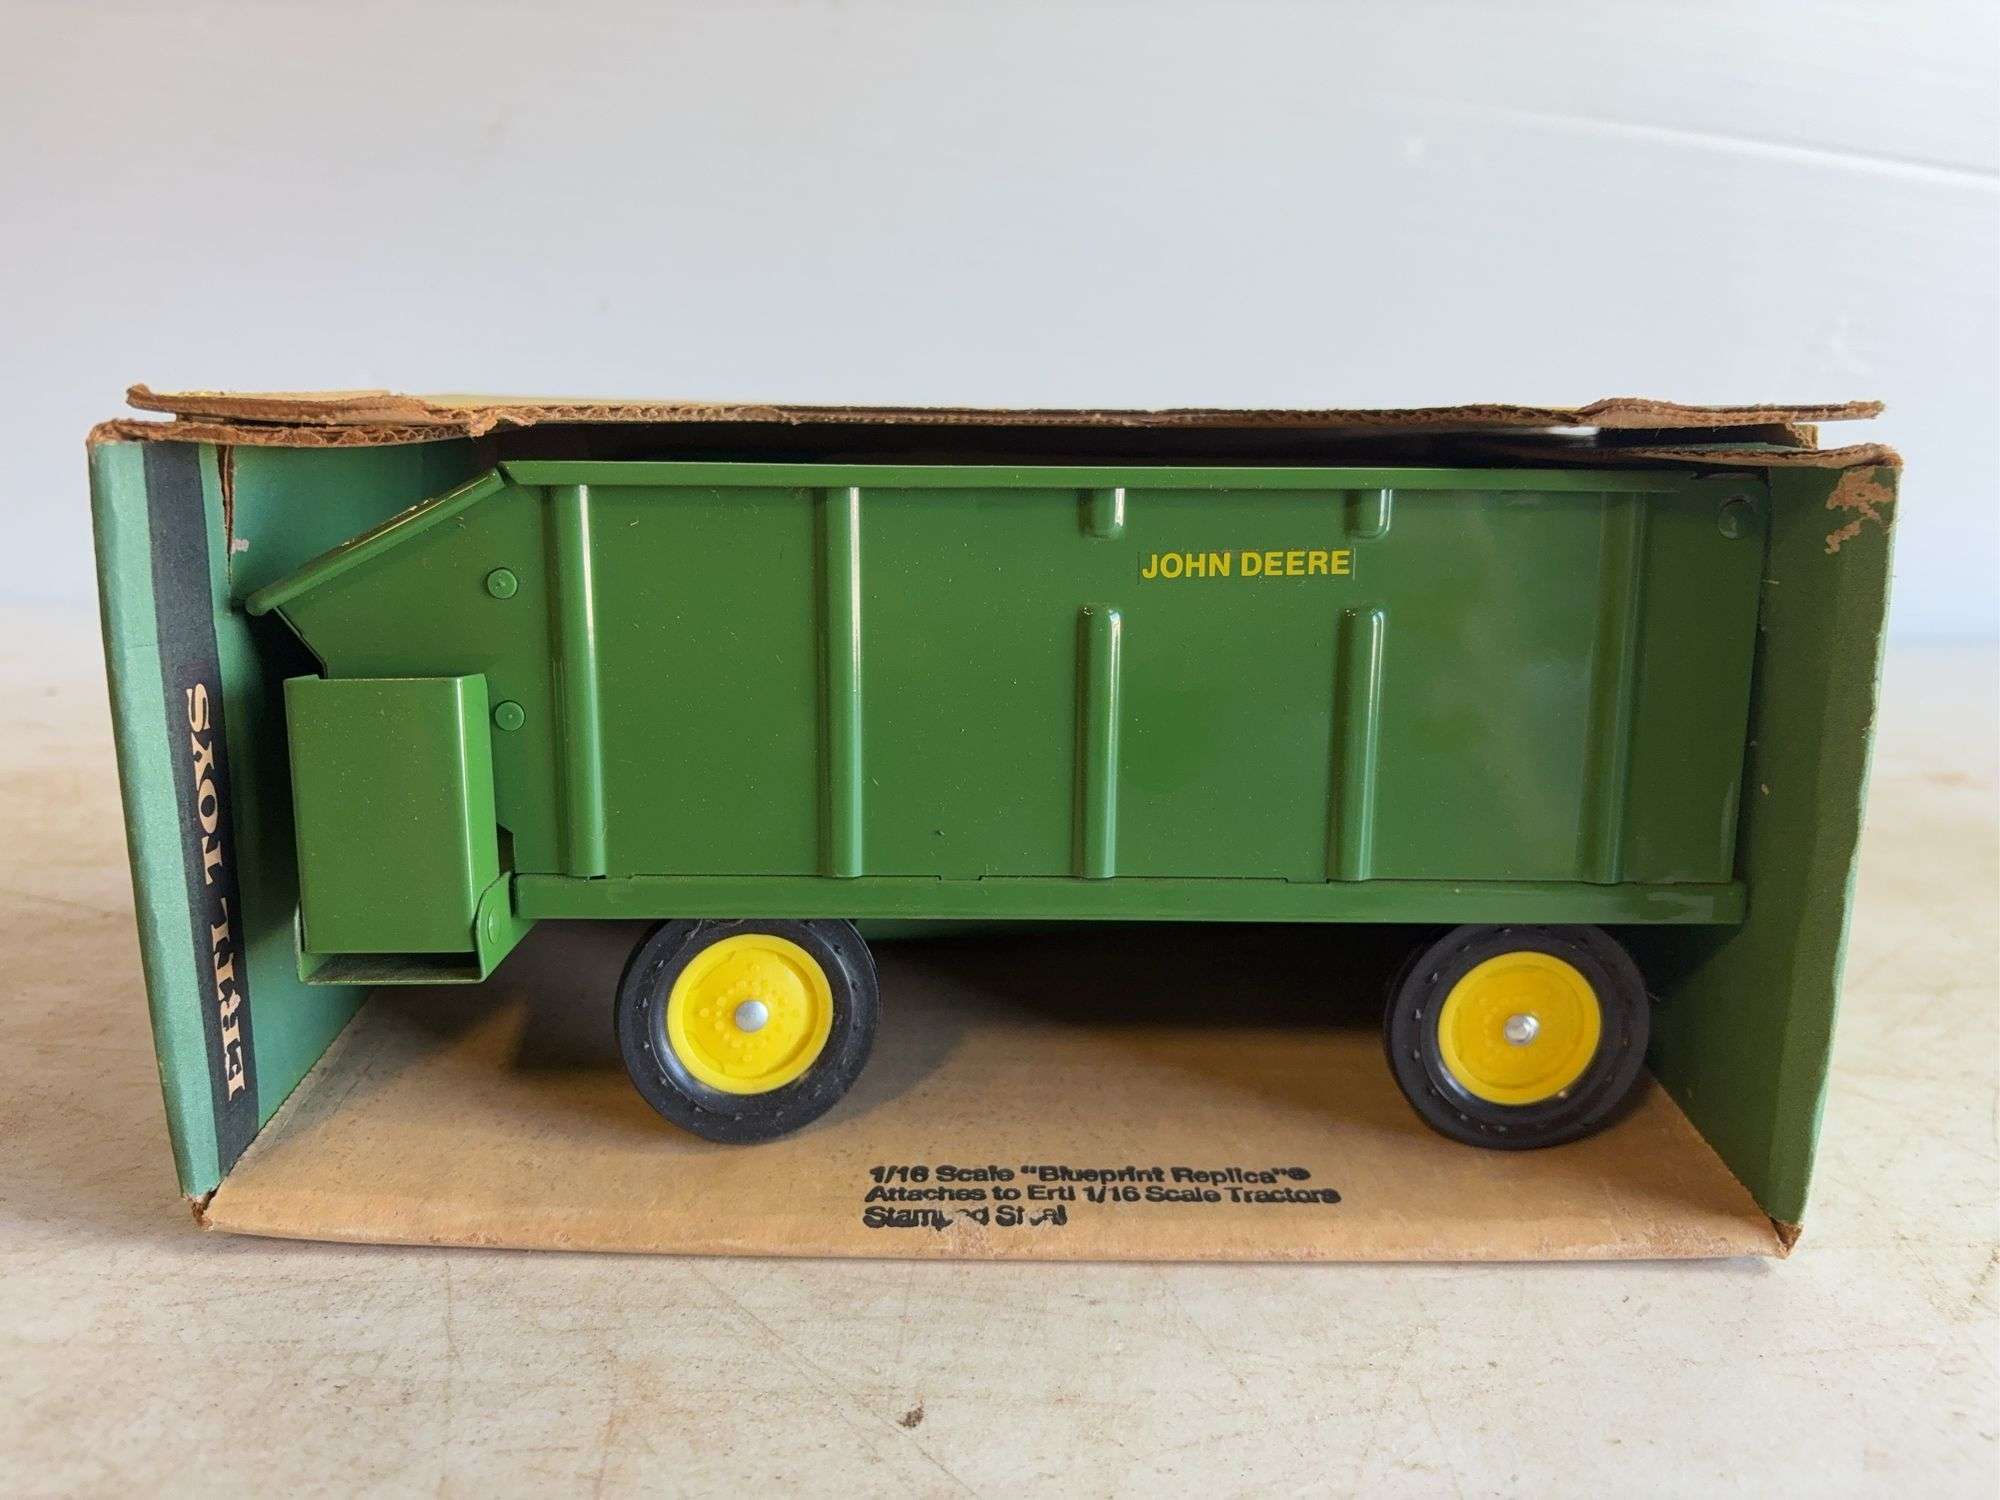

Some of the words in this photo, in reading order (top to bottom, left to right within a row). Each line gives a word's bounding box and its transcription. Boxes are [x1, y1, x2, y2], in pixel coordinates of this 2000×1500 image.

[1142, 552, 1231, 579] JOHN
[1240, 550, 1351, 577] DEERE
[185, 683, 223, 885] TOYS
[210, 896, 246, 1101] ERTL
[869, 1165, 930, 1184] 1/16
[935, 1165, 1016, 1183] Scale
[864, 1185, 987, 1203] Attaches
[991, 1186, 1022, 1202] to
[1027, 1184, 1076, 1201] Ertl
[1083, 1185, 1141, 1204] 1/16
[1145, 1185, 1222, 1204] Scale
[1223, 1186, 1342, 1204] Tractors
